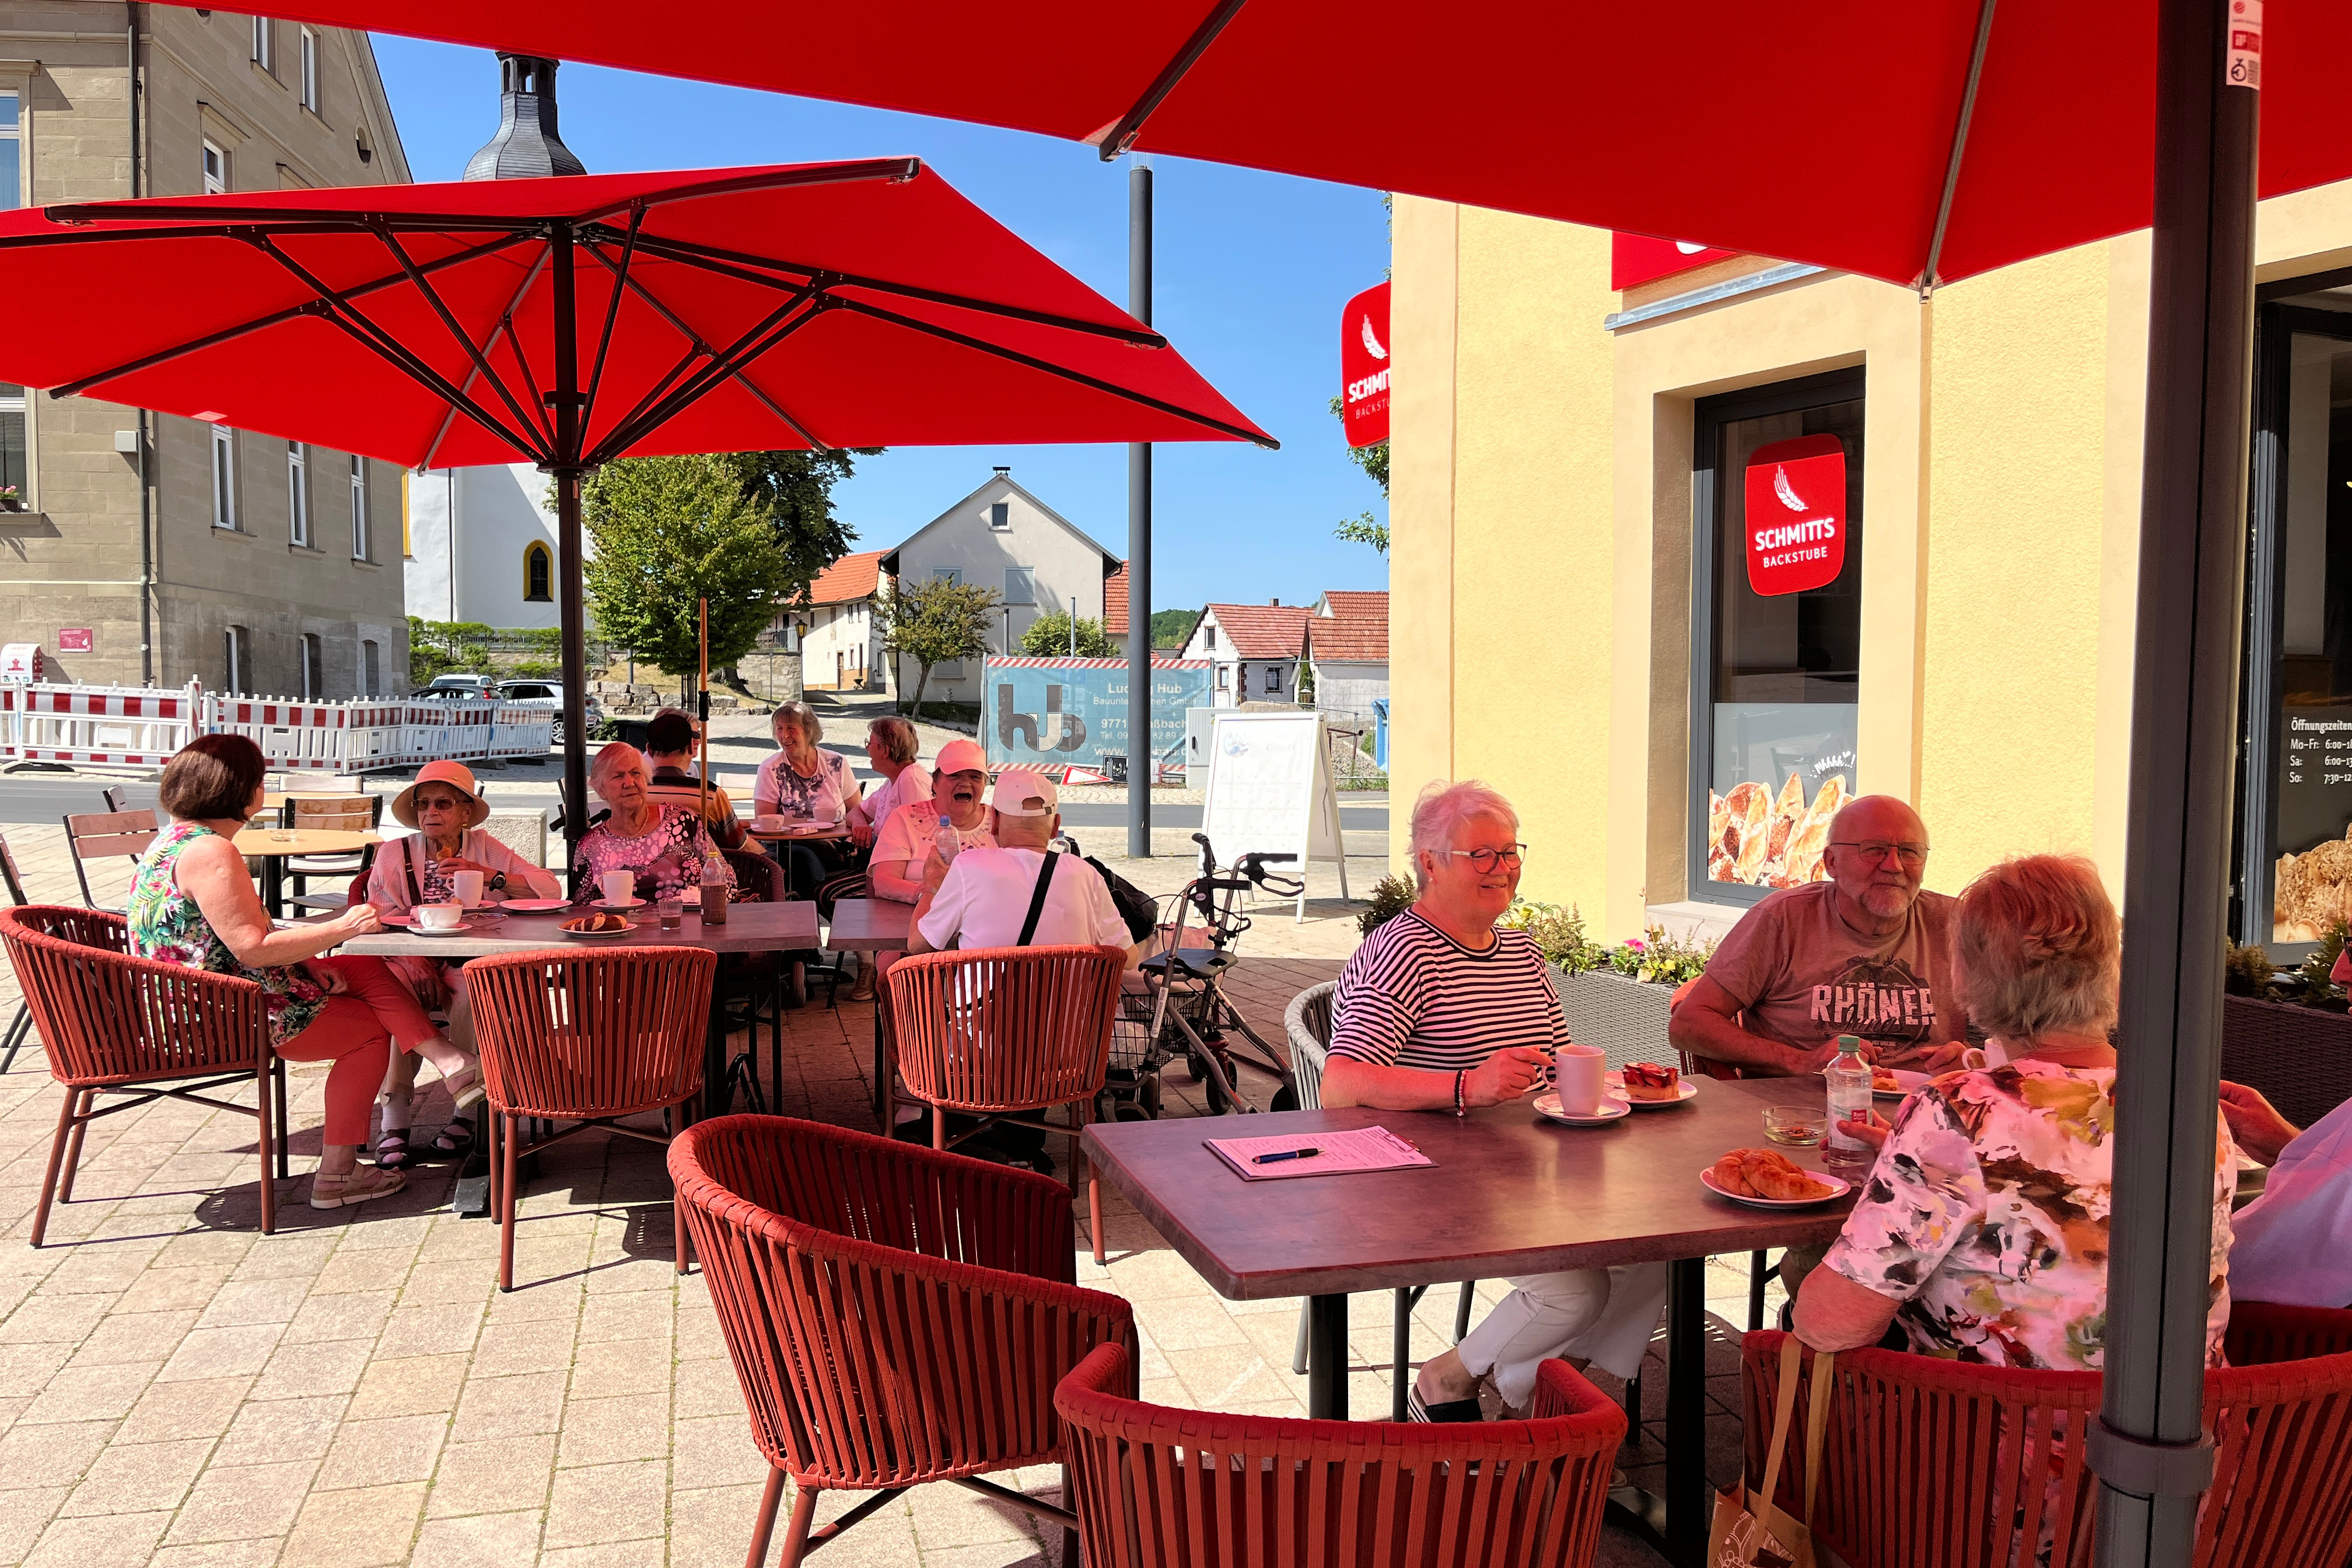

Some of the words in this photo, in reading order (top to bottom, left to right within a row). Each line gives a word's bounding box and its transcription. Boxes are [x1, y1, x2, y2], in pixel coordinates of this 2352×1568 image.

[1348, 368, 1391, 404] SCHMIT
[1755, 517, 1835, 551] SCHMITTS
[1763, 546, 1828, 568] BACKSTUBE
[1157, 683, 1182, 694] Hub
[1169, 697, 1196, 705] GmbH
[1100, 732, 1114, 740] Tel.
[1153, 732, 1163, 740] 82
[1166, 732, 1177, 740] 89
[2290, 755, 2303, 766] Sa:
[2289, 771, 2303, 783] So:
[1810, 982, 1938, 1026] RHÖNER
